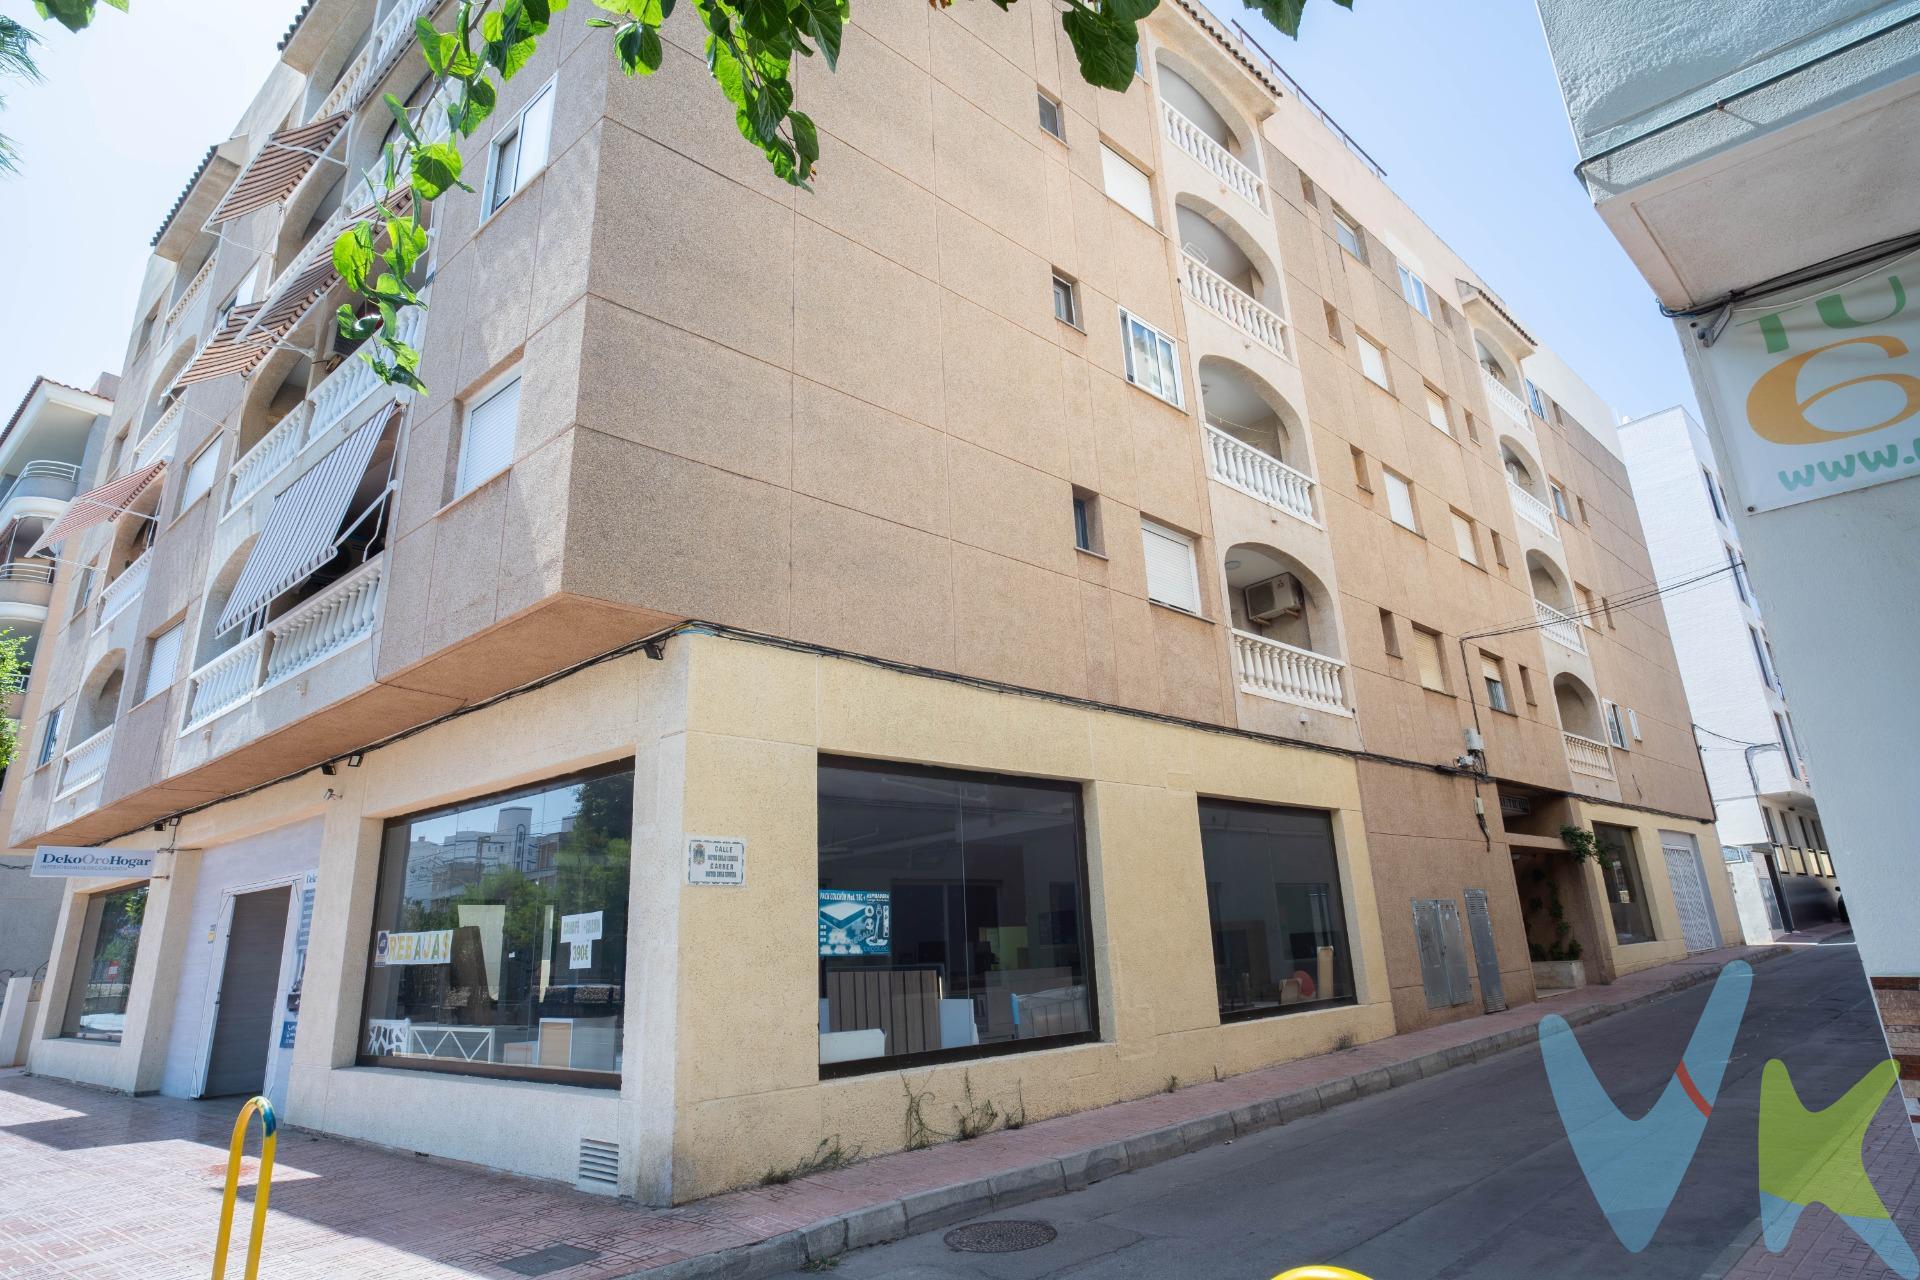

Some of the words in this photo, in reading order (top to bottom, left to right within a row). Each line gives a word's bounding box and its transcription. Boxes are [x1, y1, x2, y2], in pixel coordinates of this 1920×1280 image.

[714, 845, 733, 853] CALLE
[42, 853, 152, 869] DekoOroHogar
[388, 932, 449, 961] REBAJAS
[572, 944, 589, 961] 390€
